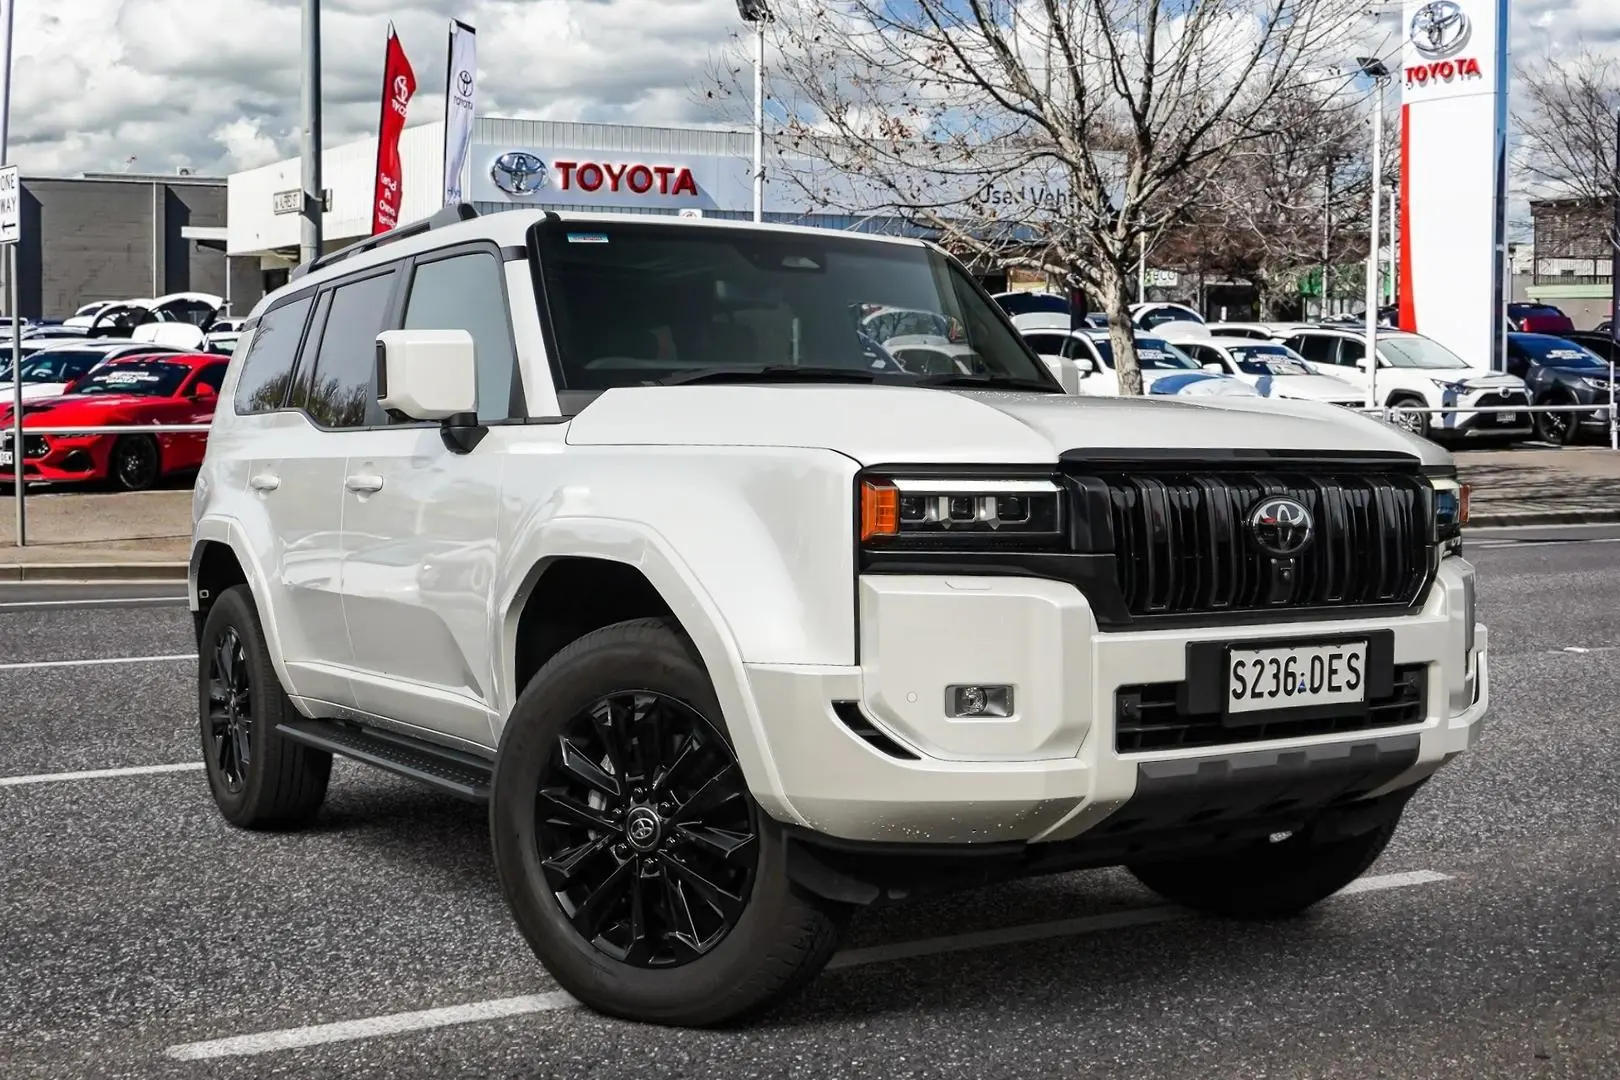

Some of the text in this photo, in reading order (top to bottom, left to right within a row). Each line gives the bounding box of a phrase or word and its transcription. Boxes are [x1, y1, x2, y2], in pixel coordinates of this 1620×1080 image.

[1404, 57, 1481, 82] TOYOTA
[0, 173, 16, 192] ONE
[555, 161, 699, 196] TOYOTA
[0, 196, 17, 214] WAY
[1231, 656, 1297, 700] S236
